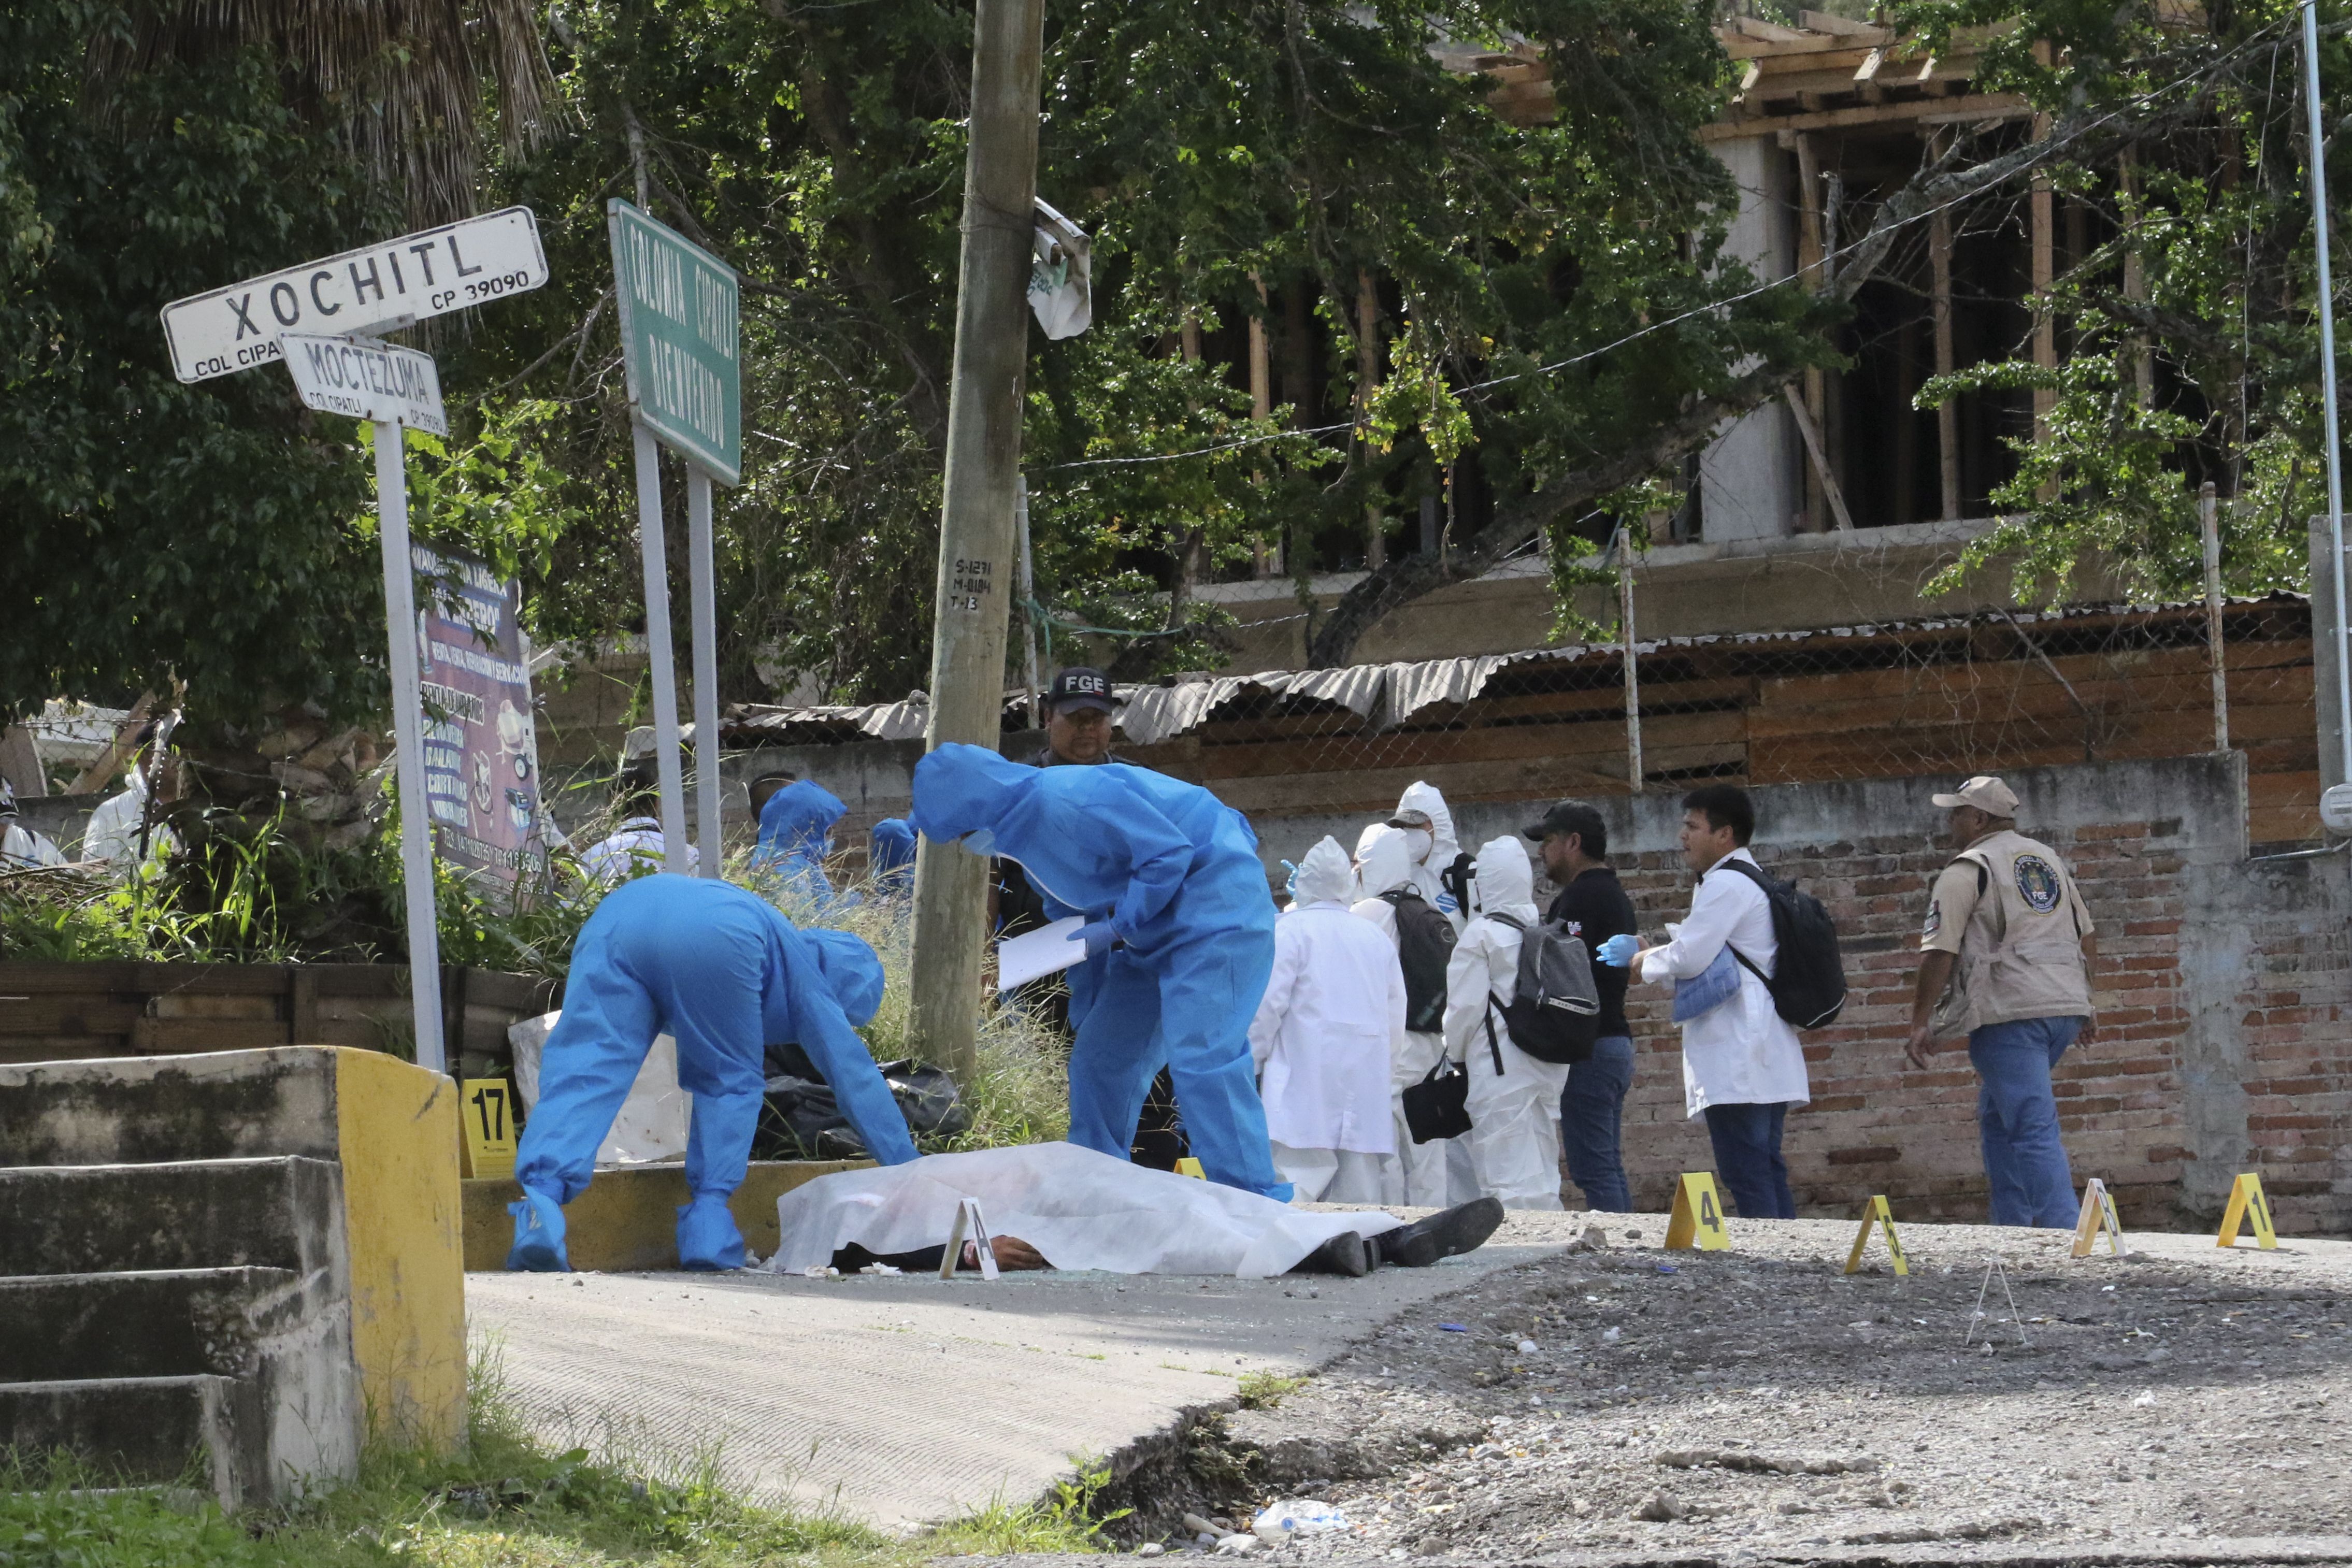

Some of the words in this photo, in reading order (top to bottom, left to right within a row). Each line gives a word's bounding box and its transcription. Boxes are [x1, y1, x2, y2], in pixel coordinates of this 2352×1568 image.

[226, 235, 482, 341] XOCHITL
[432, 290, 455, 310] CP
[465, 271, 528, 300] 39090
[630, 223, 686, 326] COLONIA
[695, 264, 732, 360] CIPATLI
[195, 355, 232, 377] COL
[237, 341, 281, 366] CIPA
[304, 342, 429, 405] MOCTEZUMA
[309, 392, 328, 408] COL
[328, 395, 362, 414] CIPATLI
[649, 334, 724, 449] BIENVENIDO
[410, 408, 419, 424] CP
[421, 412, 443, 431] 39090
[1065, 675, 1104, 693] FGE
[2031, 891, 2048, 900] FGE
[472, 1088, 504, 1141] 17
[1701, 1191, 1719, 1233] 4
[2251, 1191, 2268, 1232] 1
[1883, 1215, 1900, 1259] 5
